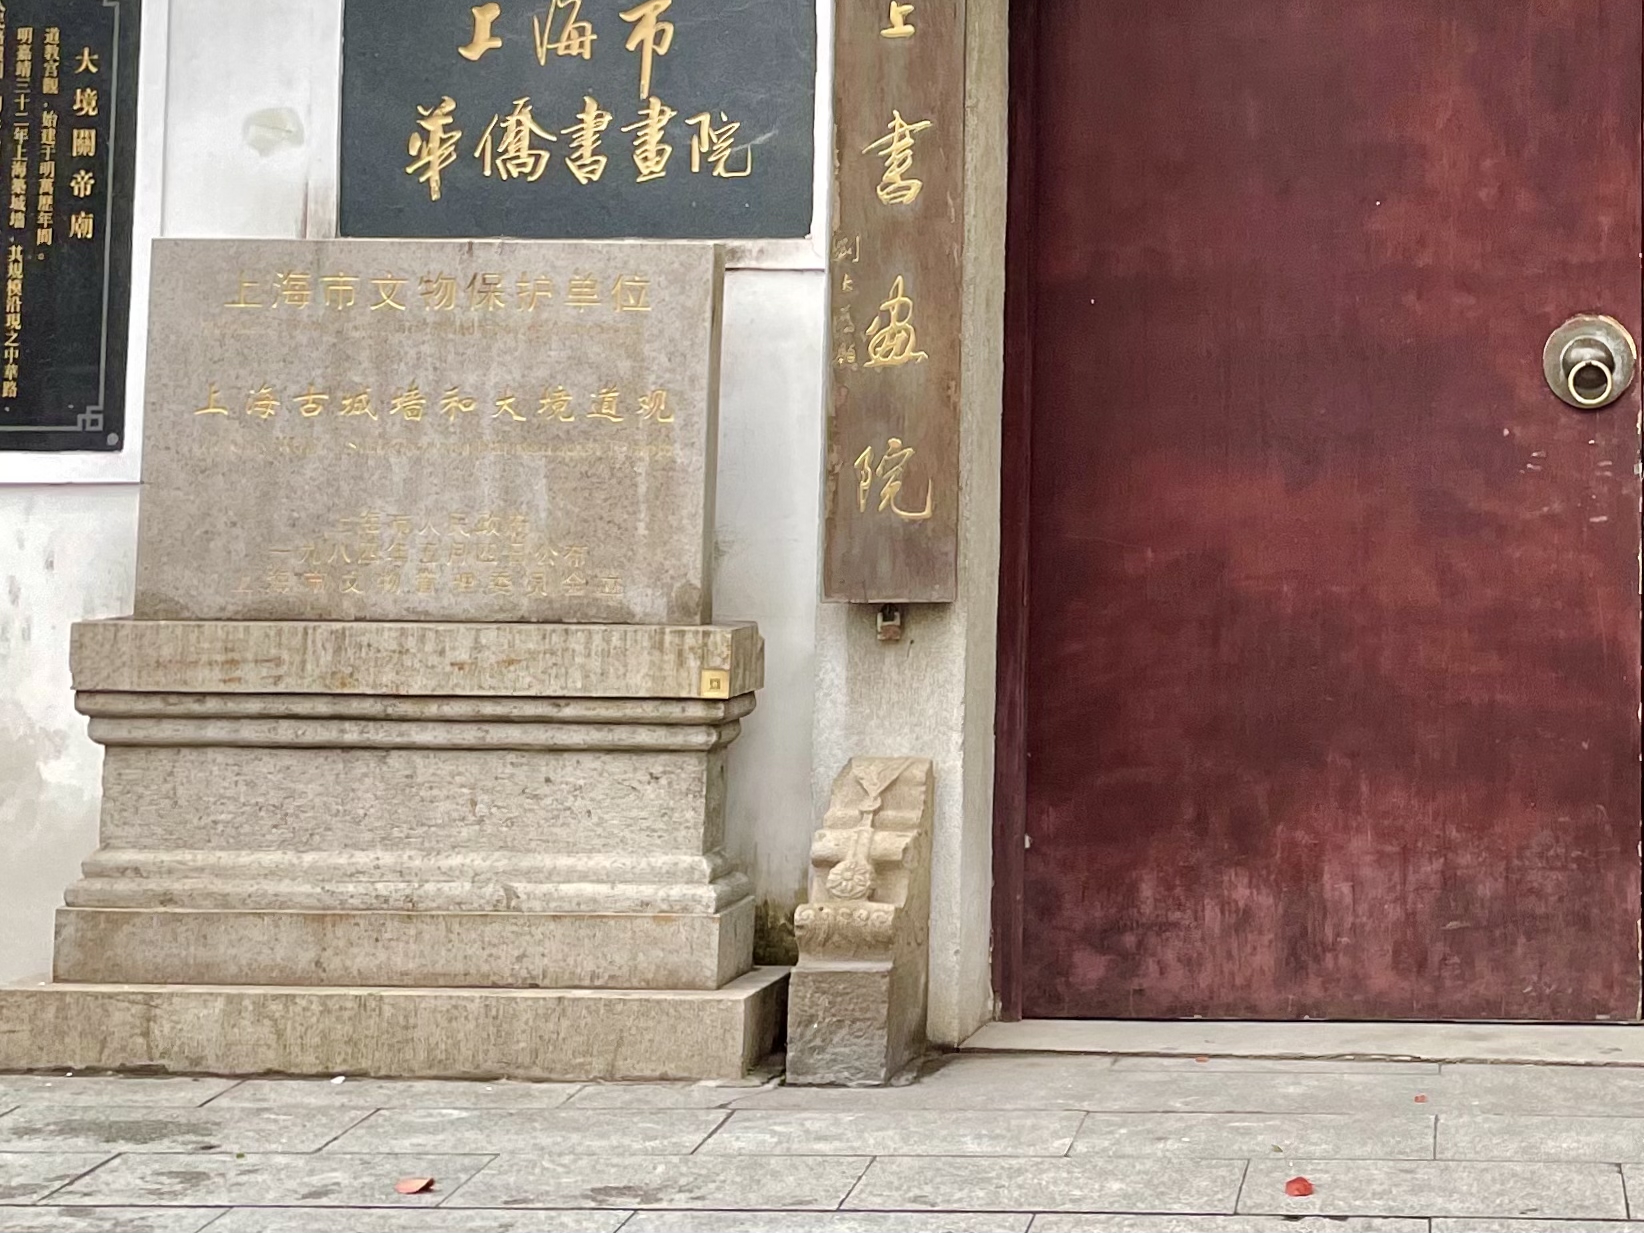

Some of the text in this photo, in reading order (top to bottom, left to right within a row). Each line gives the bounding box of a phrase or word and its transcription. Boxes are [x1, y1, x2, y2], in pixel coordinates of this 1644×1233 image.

[223, 270, 654, 314] 上海市文物保护单位
[193, 377, 676, 423] 上海古城墙和大境道观
